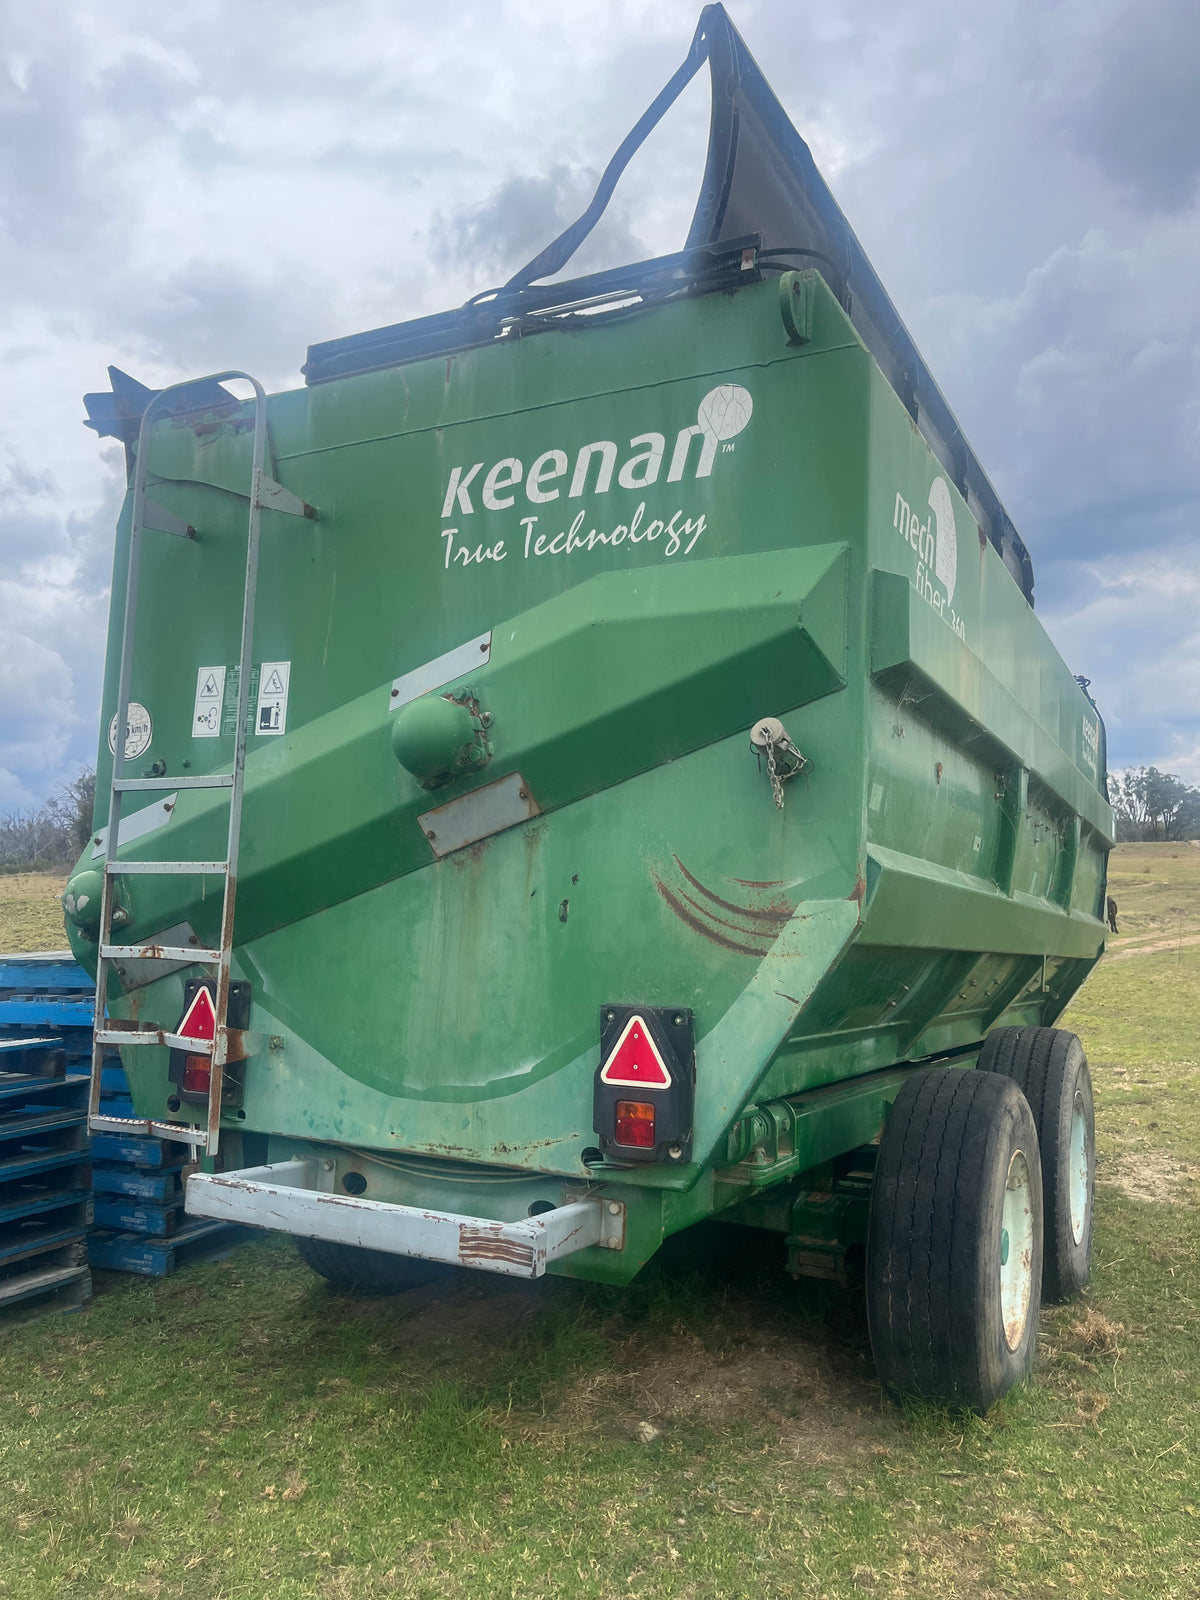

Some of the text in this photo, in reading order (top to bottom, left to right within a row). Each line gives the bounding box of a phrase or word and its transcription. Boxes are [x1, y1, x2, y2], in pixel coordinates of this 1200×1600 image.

[441, 501, 708, 569] True Technology
[893, 491, 935, 570] mech
